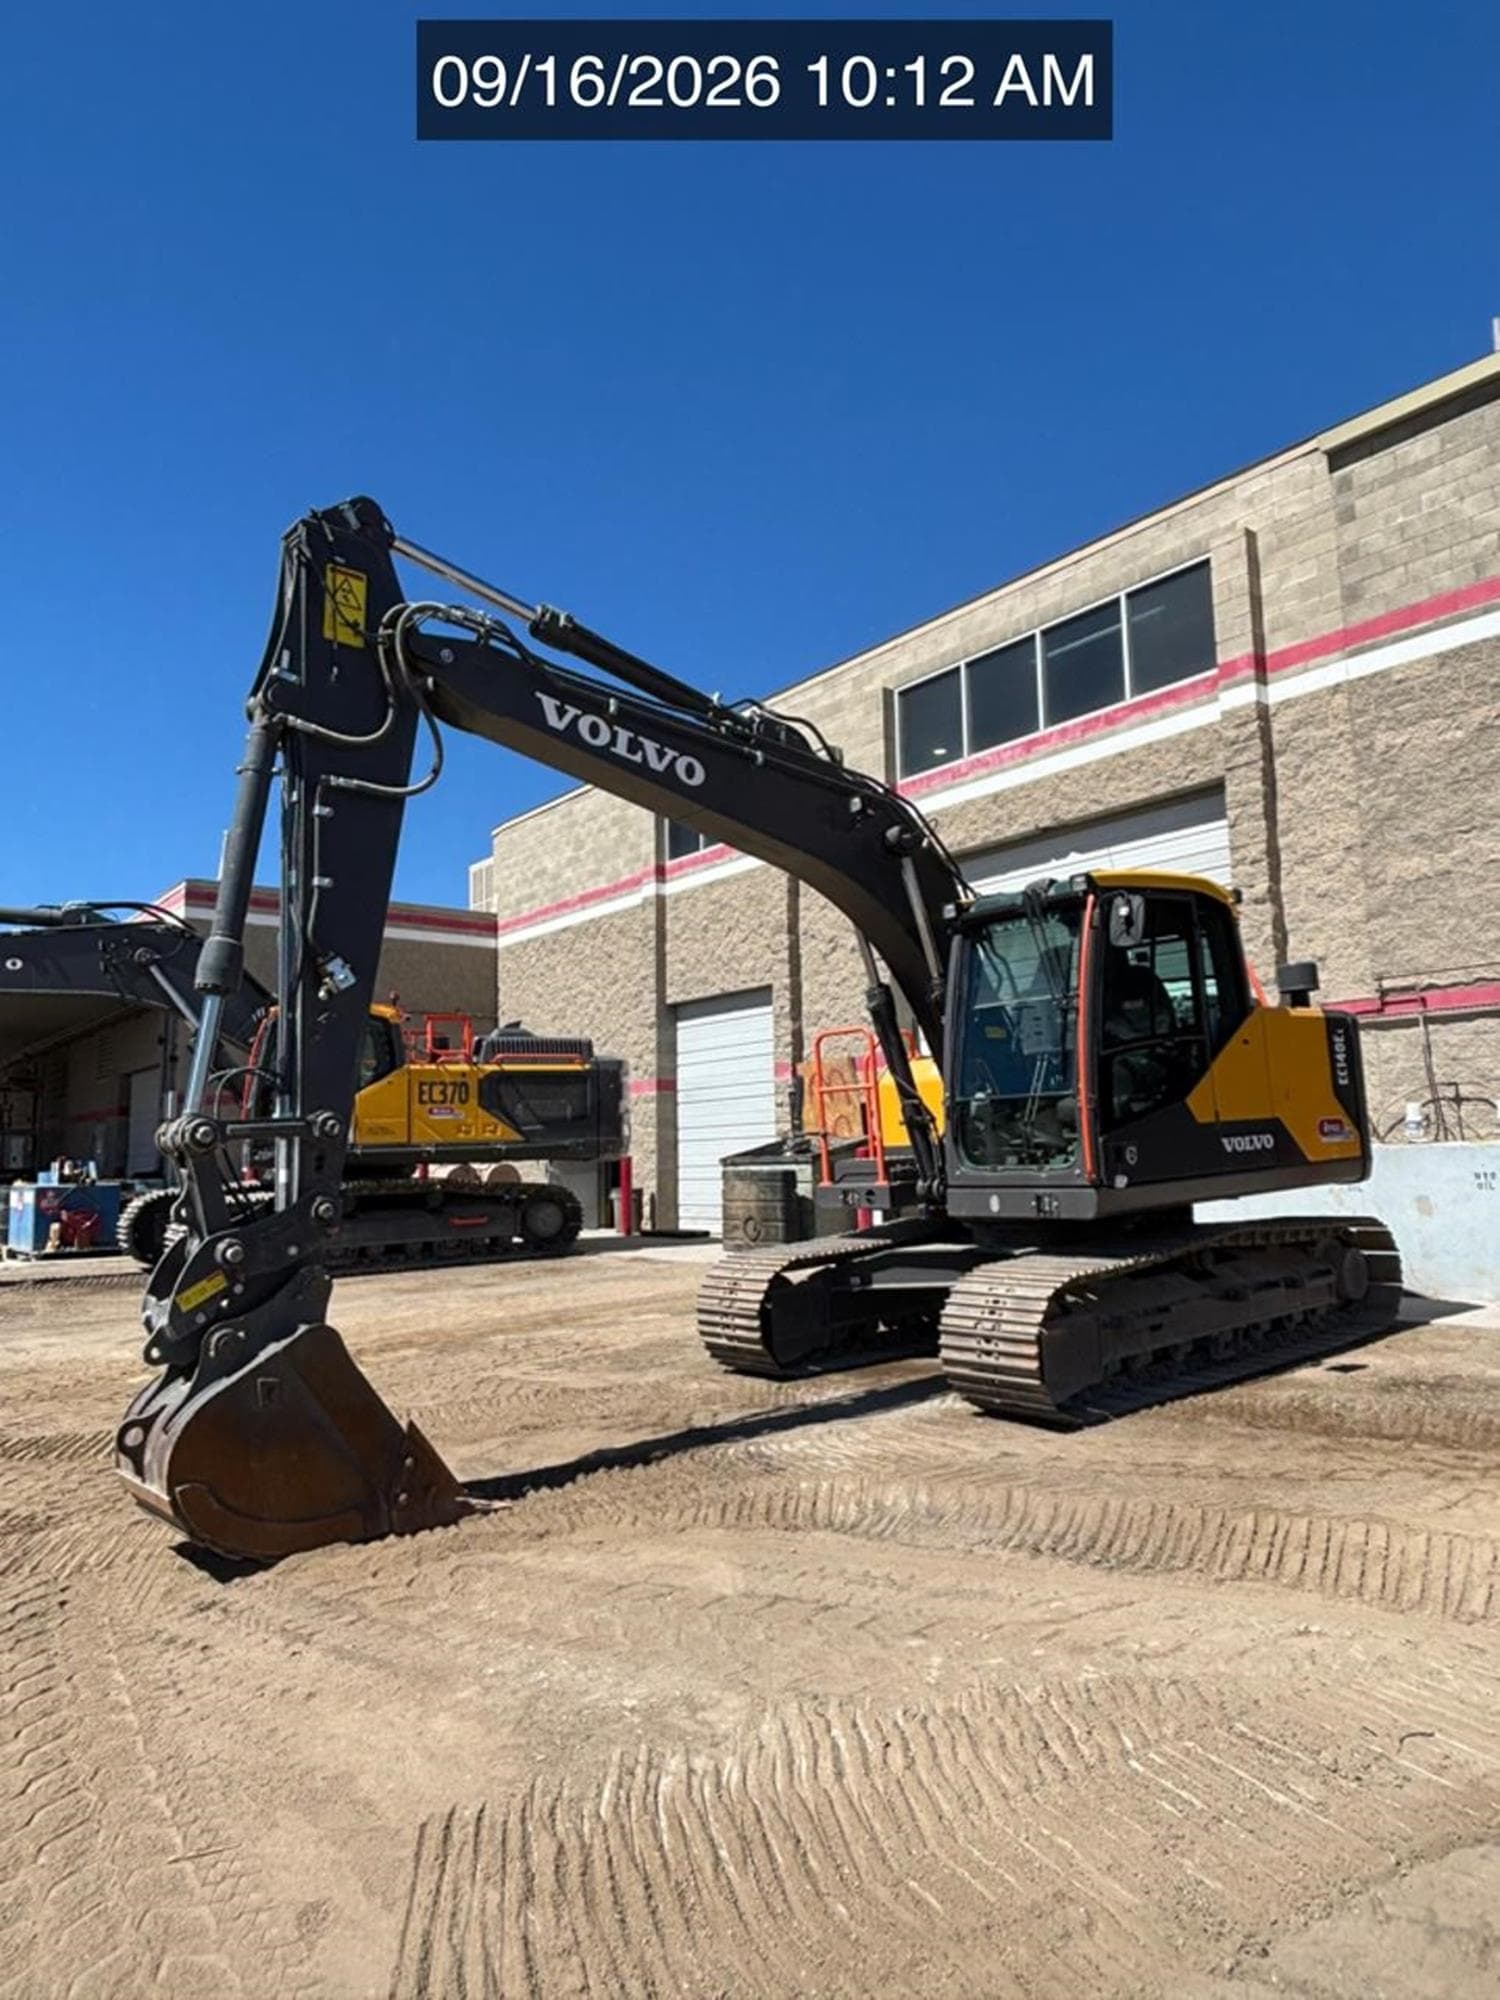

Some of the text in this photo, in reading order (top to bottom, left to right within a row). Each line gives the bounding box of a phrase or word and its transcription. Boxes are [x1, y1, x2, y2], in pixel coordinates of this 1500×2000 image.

[534, 690, 706, 787] VOLVO
[418, 1080, 470, 1105] EC370
[1221, 1133, 1275, 1153] VOLVO
